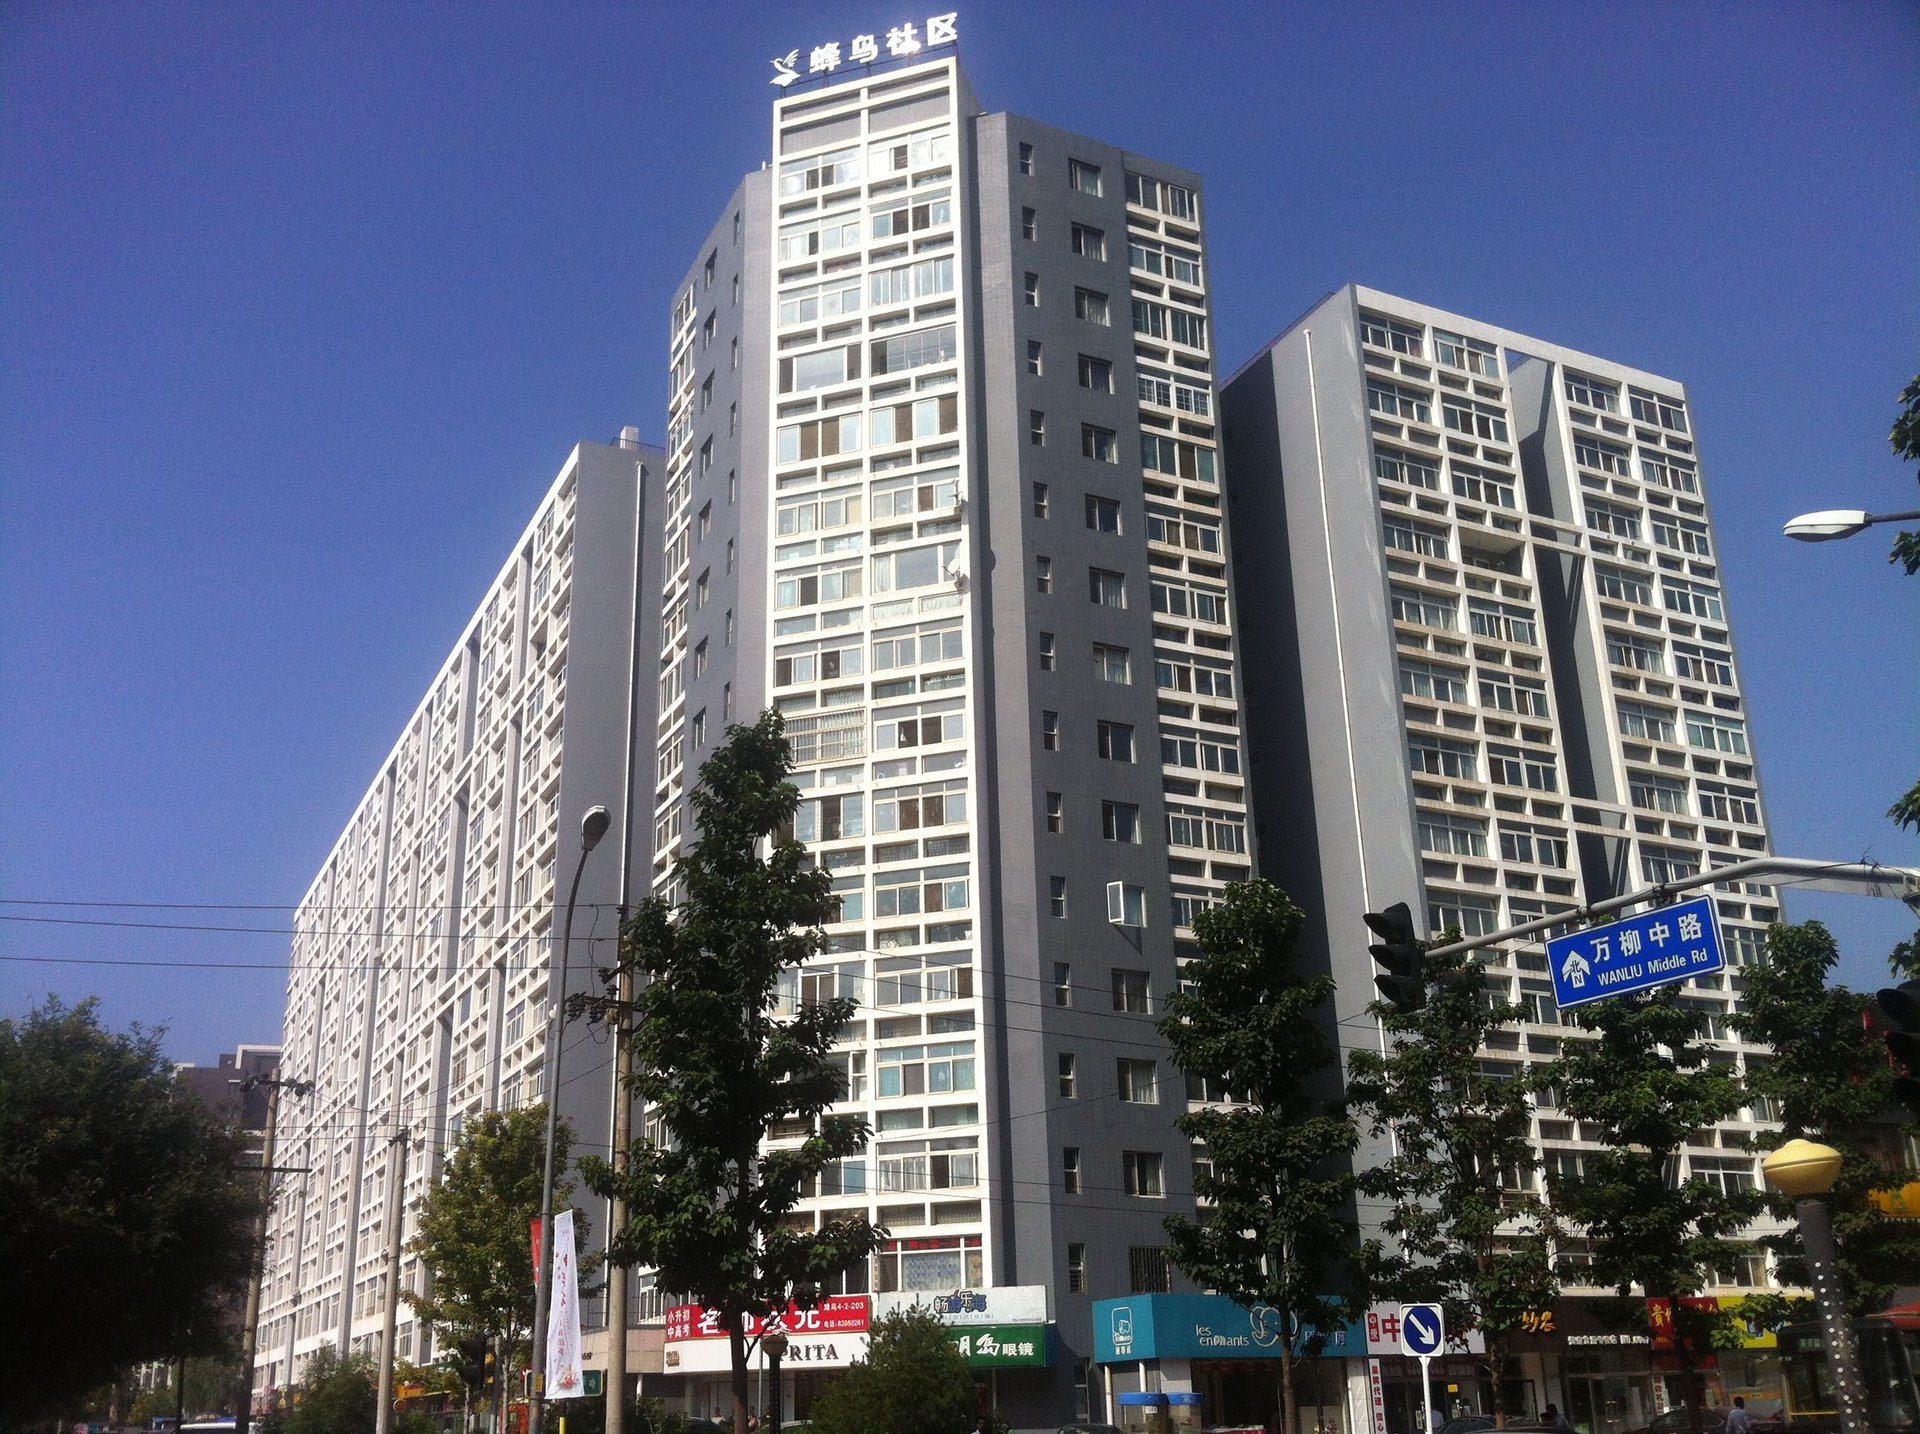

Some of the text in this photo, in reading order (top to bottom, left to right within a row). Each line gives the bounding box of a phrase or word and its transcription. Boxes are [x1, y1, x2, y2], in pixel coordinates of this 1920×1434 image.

[809, 12, 958, 73] 蜂鸟社区
[1590, 913, 1702, 964] 万柳中路
[1597, 948, 1708, 987] WANLIU Middle Rd
[1573, 974, 1583, 985] N
[667, 1308, 691, 1325] 小升初
[667, 1323, 691, 1339] 中高考
[1195, 1323, 1212, 1336] les
